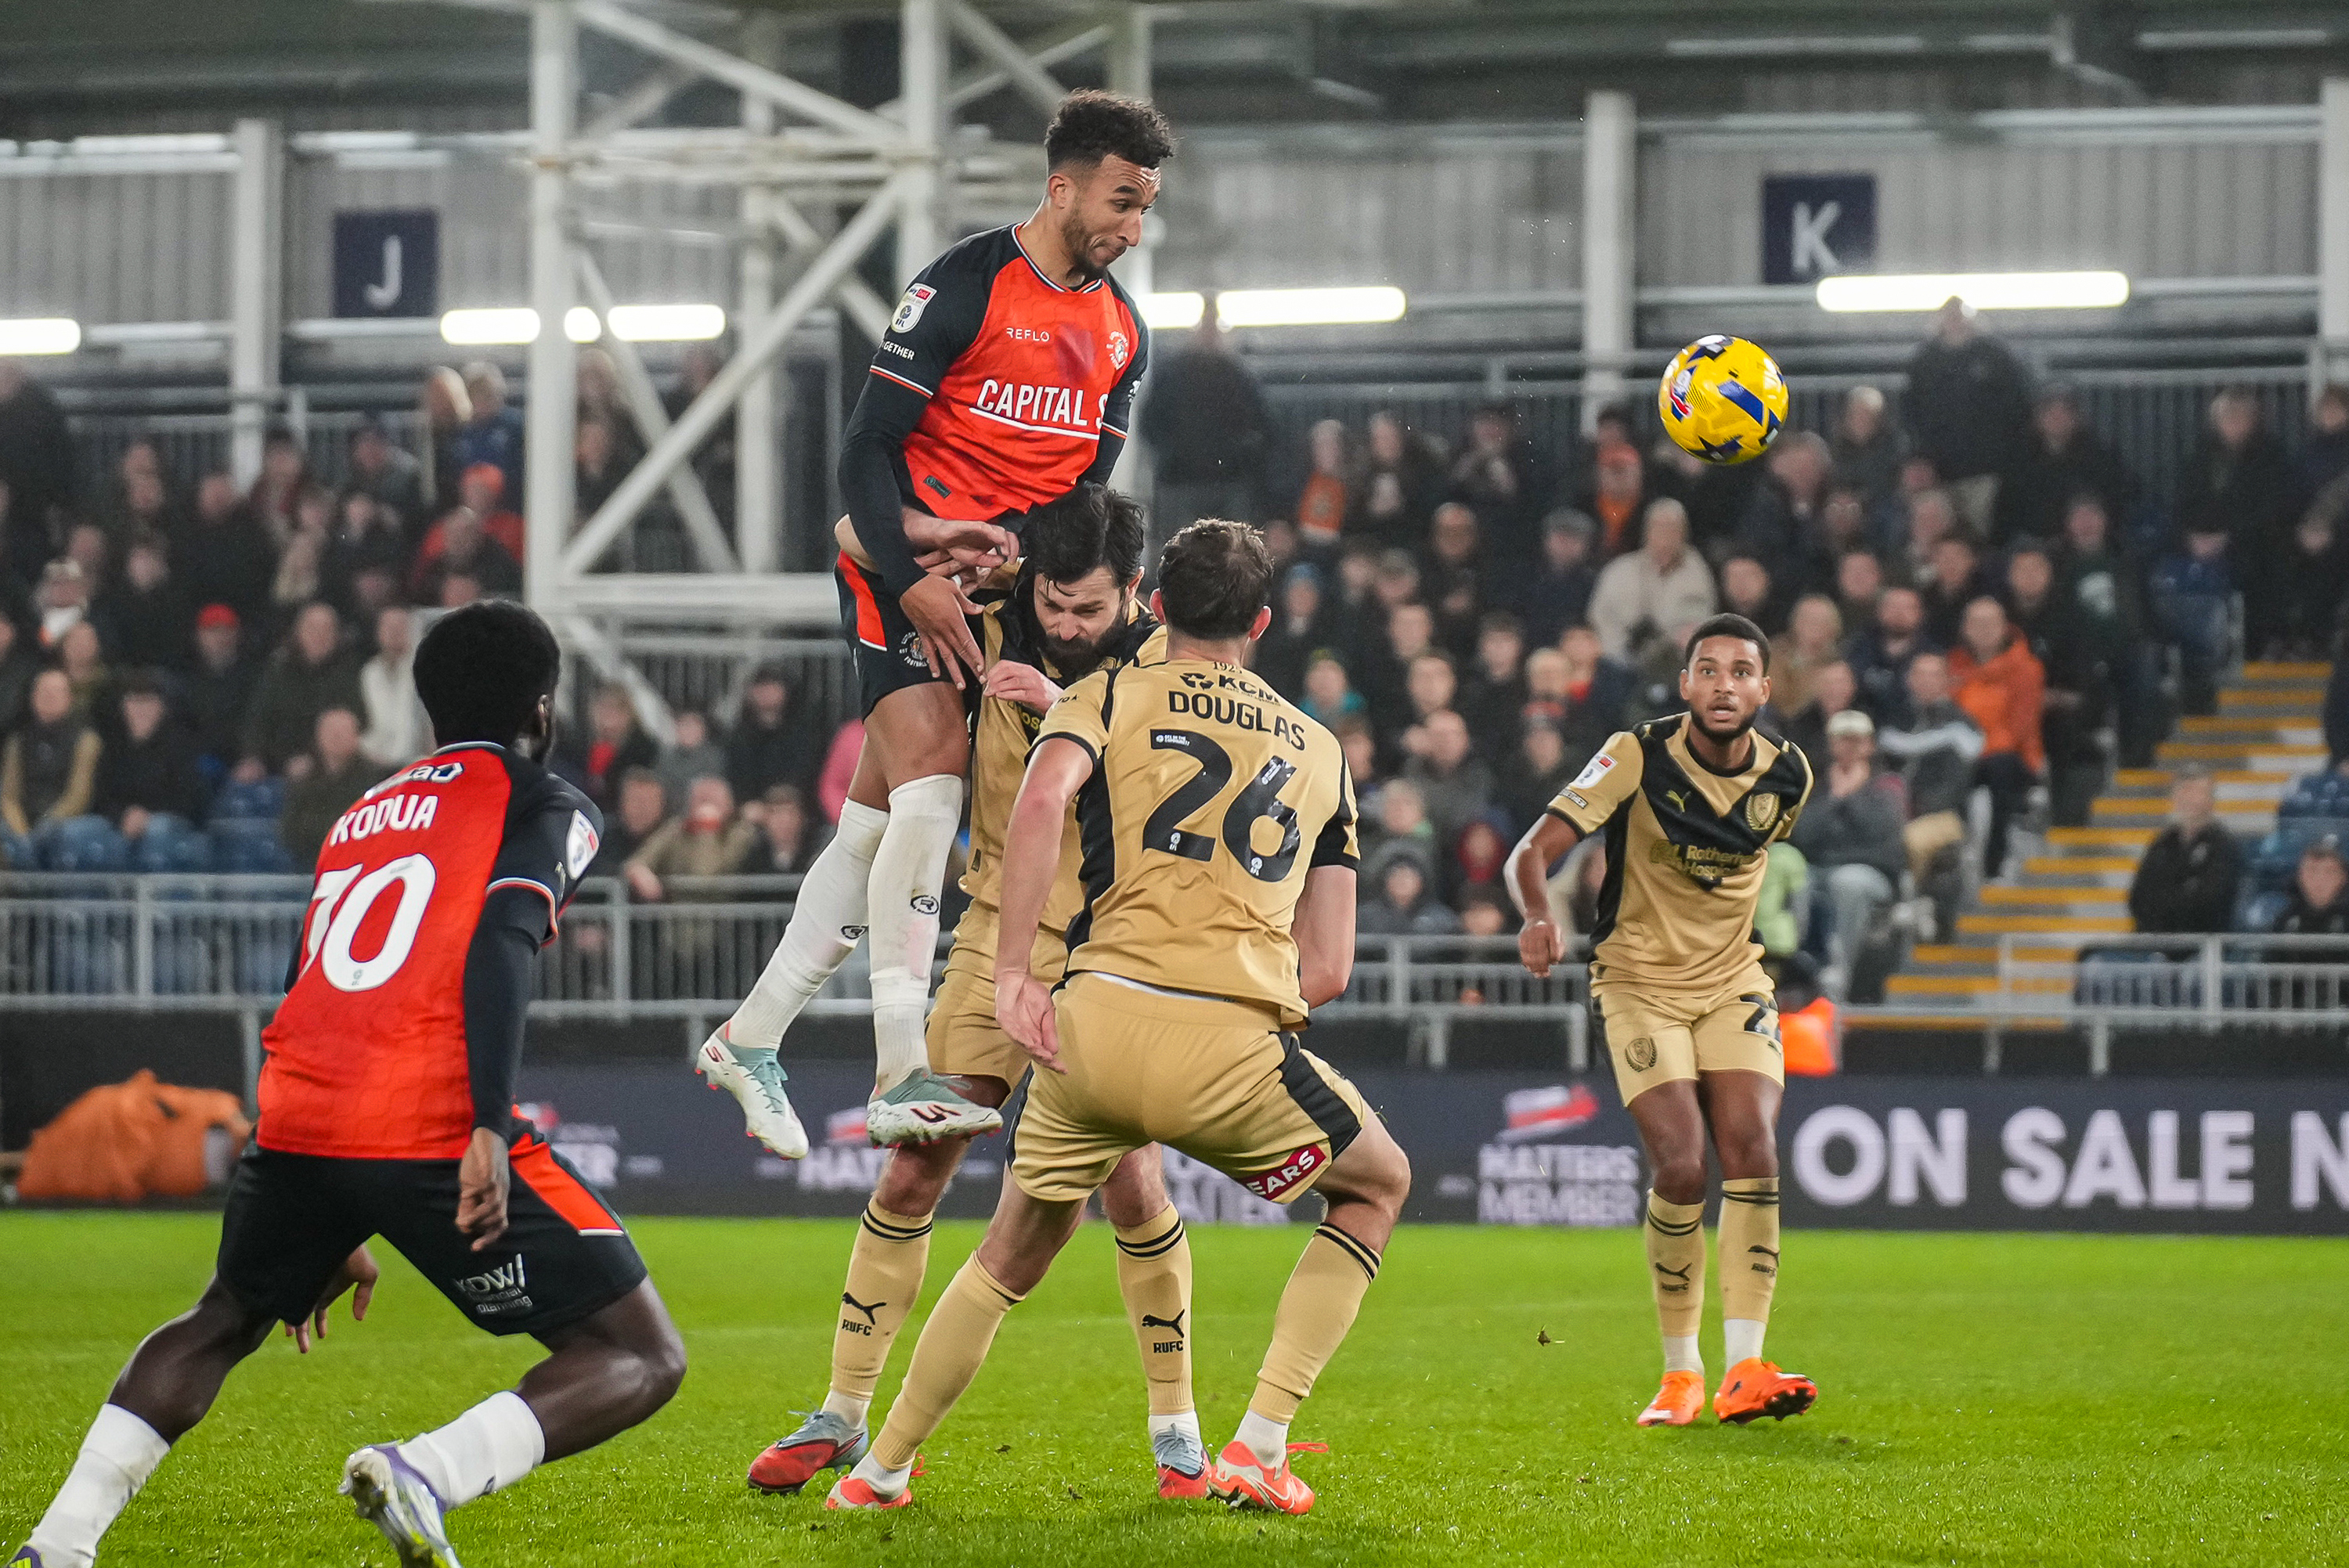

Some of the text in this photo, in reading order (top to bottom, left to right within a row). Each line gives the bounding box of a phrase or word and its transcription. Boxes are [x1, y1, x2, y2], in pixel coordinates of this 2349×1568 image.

[1792, 201, 1840, 272] K
[363, 235, 402, 311] J
[882, 341, 915, 360] GETHER
[1006, 326, 1050, 342] REFLO
[976, 379, 1088, 427] CAPITAL
[1168, 690, 1305, 751] DOUGLAS
[329, 794, 438, 846] KODUA
[1142, 729, 1301, 882] 26
[1792, 1105, 1968, 1207] ON
[2000, 1105, 2255, 1211] SALE
[841, 1318, 873, 1337] RUFC
[1153, 1339, 1184, 1354] RUFC
